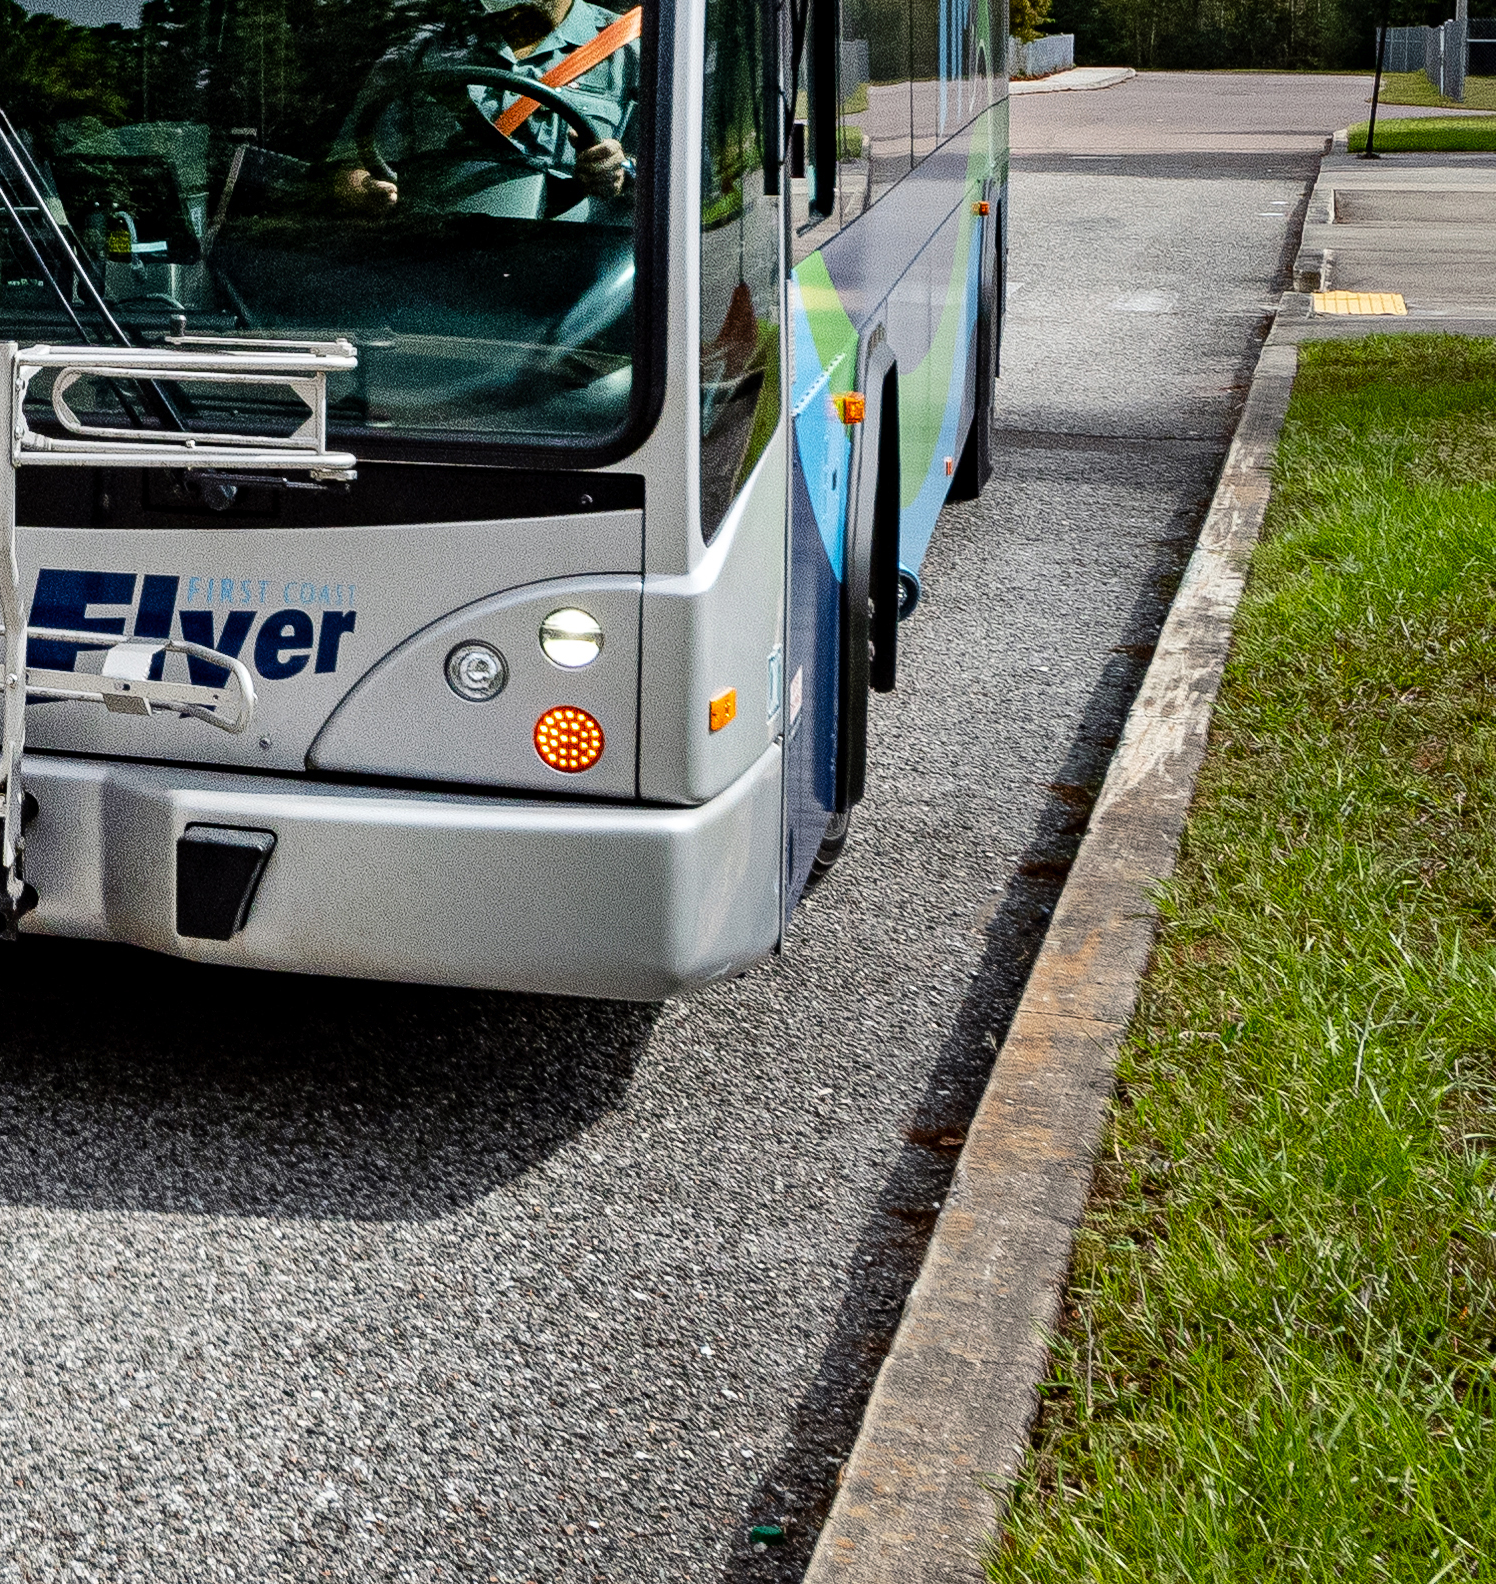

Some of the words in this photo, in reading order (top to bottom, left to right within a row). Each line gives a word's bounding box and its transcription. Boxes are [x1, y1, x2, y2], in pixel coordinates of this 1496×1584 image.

[187, 576, 271, 604] FIRST
[283, 581, 356, 606] COAST
[25, 568, 357, 719] Flyer
